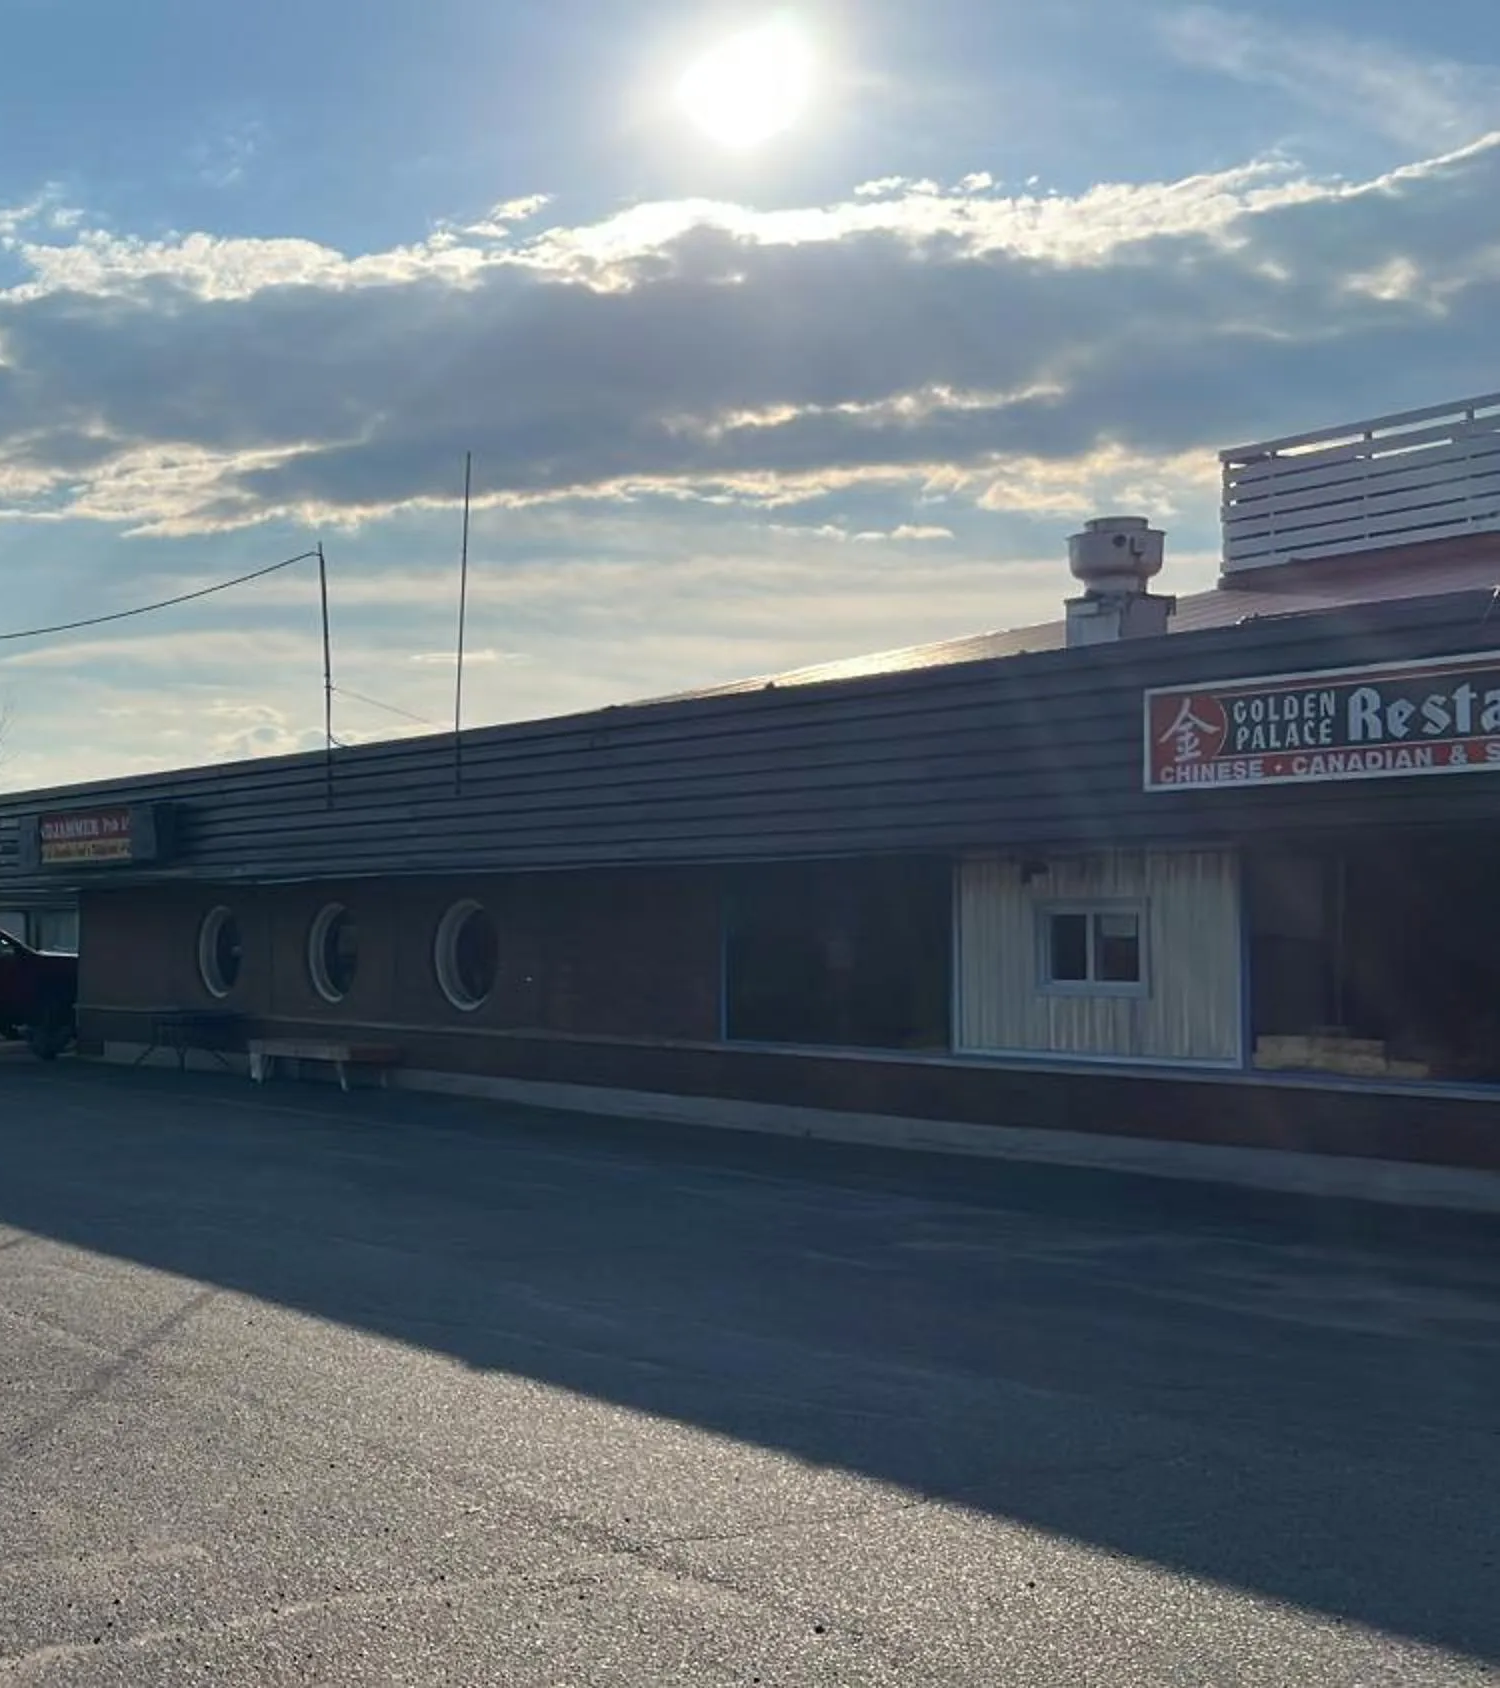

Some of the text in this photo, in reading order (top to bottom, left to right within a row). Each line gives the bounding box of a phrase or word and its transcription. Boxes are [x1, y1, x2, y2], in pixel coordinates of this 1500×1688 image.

[1233, 691, 1336, 723] GOLDEN
[1159, 699, 1221, 763] 金
[1236, 719, 1334, 751] PALACE
[1159, 759, 1264, 783] CHINESE
[1291, 746, 1434, 775] CANADIAN
[1449, 742, 1469, 764] &
